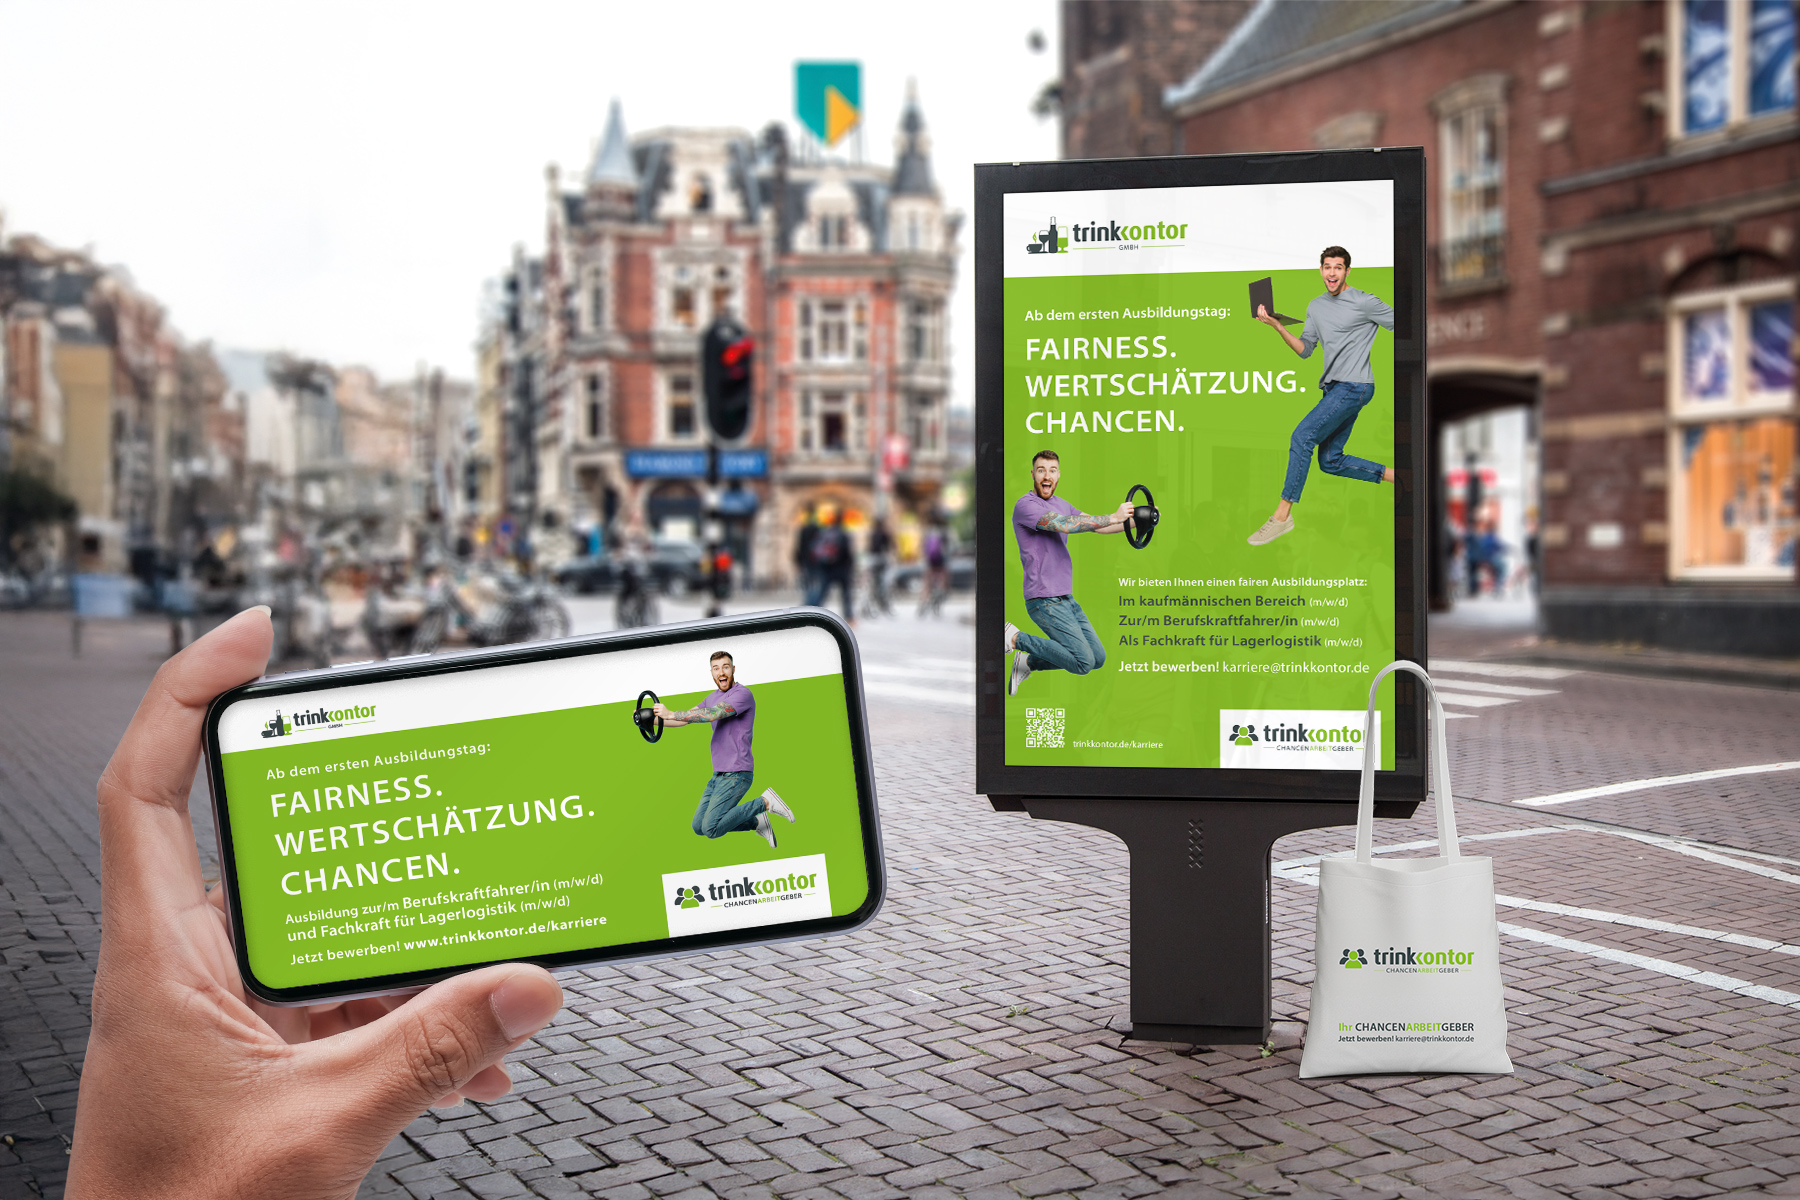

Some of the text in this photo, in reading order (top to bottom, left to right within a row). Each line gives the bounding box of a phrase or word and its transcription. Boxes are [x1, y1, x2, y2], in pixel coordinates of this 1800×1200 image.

[1072, 220, 1189, 243] trinkkontor
[1024, 305, 1231, 322] Ab dem ersten Ausbildungstag:
[1026, 335, 1177, 361] FAIRNESS.
[1024, 367, 1306, 398] WERTSCHÄTZUNG.
[1025, 409, 1185, 434] CHANCEN.
[1118, 577, 1368, 589] Wir bieten Ihnen einen fairen Ausbildungsplatz:
[1119, 594, 1349, 608] Im kaufmännischen Bereich (m/w/d)
[1118, 614, 1340, 627] Zur/m Berufskraftfahrer/in (m/w/d)
[1118, 634, 1363, 650] Als Fachkraft für Lagerlogistik (m/w/d)
[1118, 660, 1370, 674] Jetzt bewerben! karriere@trinkkontor.de
[293, 705, 376, 728] trinkkontor
[1072, 739, 1164, 749] trinkkontor.de/karriere
[1263, 723, 1365, 743] trinkkonto
[266, 743, 491, 781] Ab dem ersten Ausbildungstag:
[270, 774, 443, 818] FAIRNESS.
[274, 794, 595, 857] WERTSCHÄTZUNG.
[281, 852, 460, 896] CHANCEN.
[708, 873, 817, 901] trinkkontor
[285, 873, 604, 925] Ausbildung zur/m Berufskraftfahrer/in (m/w/d)
[723, 893, 803, 908] CHANCENARBEITGEBER
[287, 895, 570, 942] und Fachkraft für Lagerlogistik (m/w/d)
[290, 916, 607, 966] Jetzt bewerben! www.trinkkontor.de/karriere
[1373, 947, 1475, 965] trinkkontor
[1338, 1022, 1474, 1032] Ihr CHANCENARBEITGEBER
[1395, 1035, 1475, 1043] karriere@trinkkontor.de
